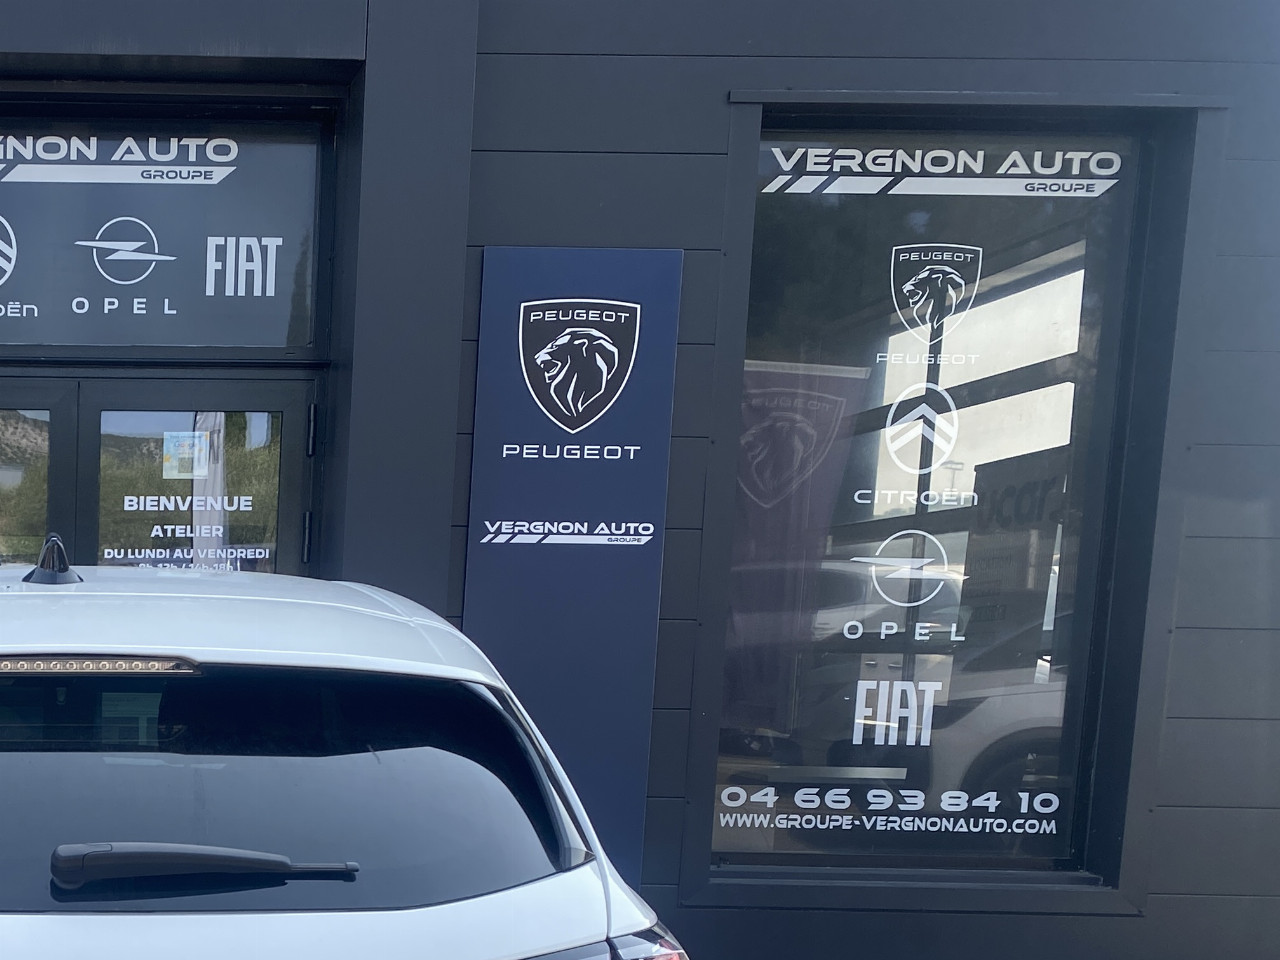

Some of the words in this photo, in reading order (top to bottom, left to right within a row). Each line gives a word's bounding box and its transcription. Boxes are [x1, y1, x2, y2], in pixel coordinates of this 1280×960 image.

[111, 137, 239, 162] AUTO
[771, 147, 984, 174] VERGNON
[995, 151, 1121, 175] AUTO
[141, 170, 214, 180] GROUPE
[1024, 182, 1096, 193] GROUPE
[899, 252, 974, 263] PEUGEOT
[206, 236, 283, 296] FIAT
[72, 297, 177, 314] OPEL
[530, 310, 630, 323] PEUGEOT
[876, 353, 980, 365] PEUGEOT
[502, 444, 641, 460] PEUGEOT
[124, 496, 252, 511] BIENVENUE
[150, 525, 223, 538] ATELIER
[484, 520, 588, 534] VERGNON
[593, 522, 655, 534] AUTO
[104, 549, 124, 559] DU
[128, 549, 169, 559] LUNDI
[173, 549, 193, 559] AU
[198, 549, 269, 559] VENDREDI
[843, 620, 965, 641] OPEL
[852, 680, 942, 746] FIAT
[721, 786, 779, 808] 04
[794, 787, 852, 809] 66
[867, 789, 925, 811] 93
[940, 790, 1001, 813] 84
[1018, 792, 1060, 814] 10
[720, 813, 1057, 834] WWW.GROUPE-VERGNONAUTO.COM
